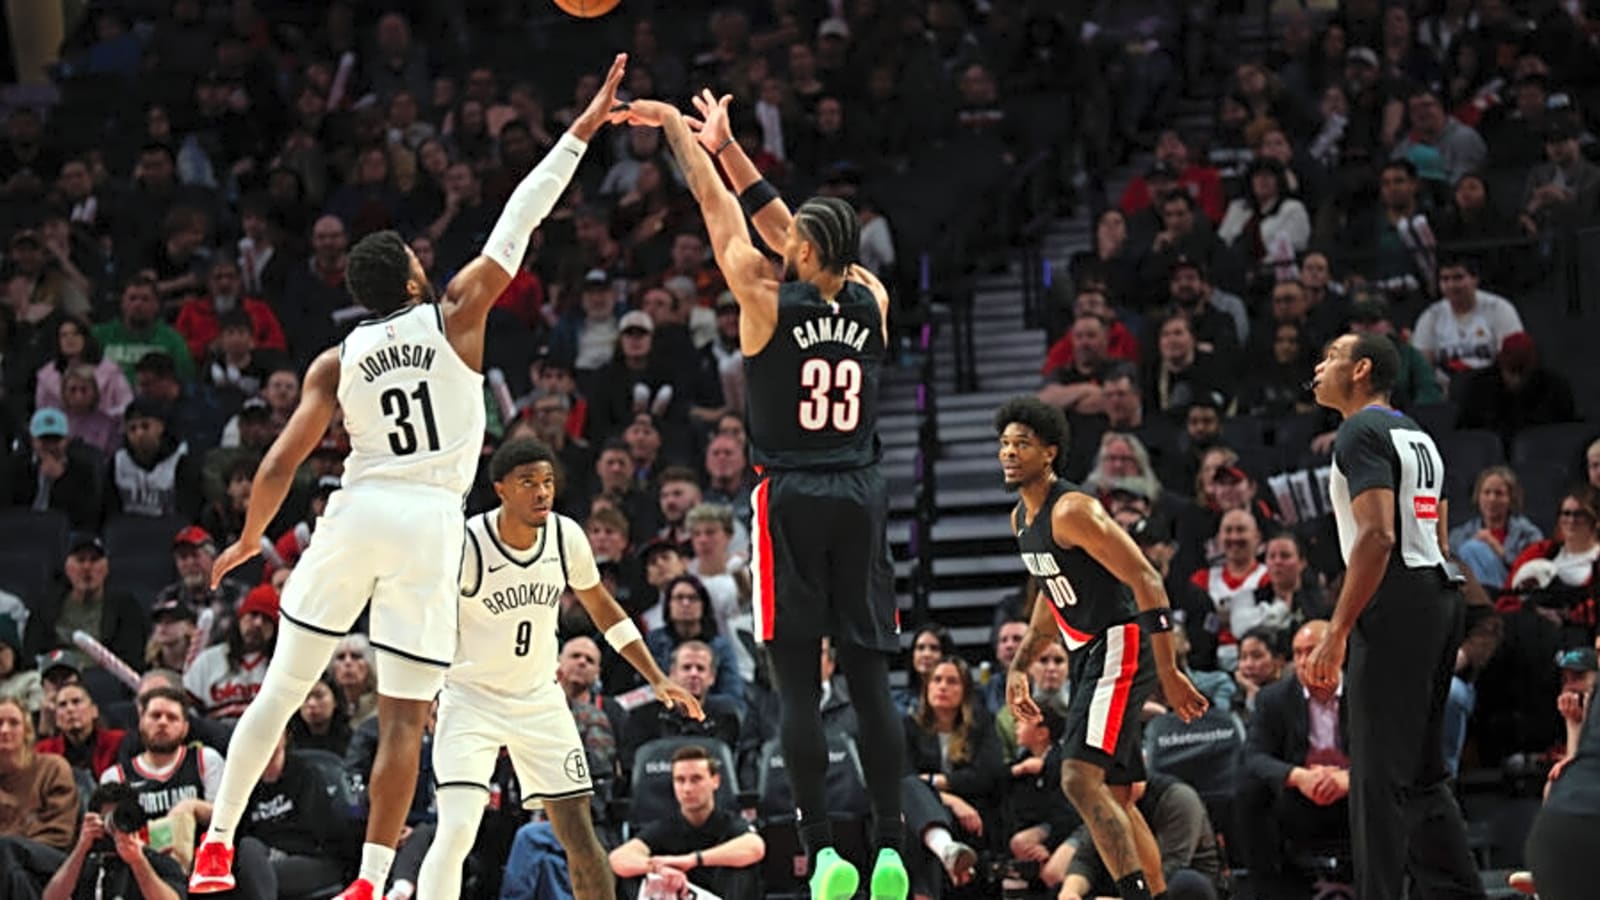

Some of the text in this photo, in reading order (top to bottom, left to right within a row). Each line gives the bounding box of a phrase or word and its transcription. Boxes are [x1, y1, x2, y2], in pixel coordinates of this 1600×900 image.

[792, 317, 870, 352] CAMARA
[358, 344, 435, 382] JOHNSON
[799, 356, 862, 432] 33
[381, 381, 439, 456] 31
[1409, 441, 1434, 488] 10
[482, 582, 559, 615] BROOKLYN
[1045, 575, 1077, 608] 00
[515, 620, 531, 656] 9
[1158, 728, 1234, 747] ticketmaster
